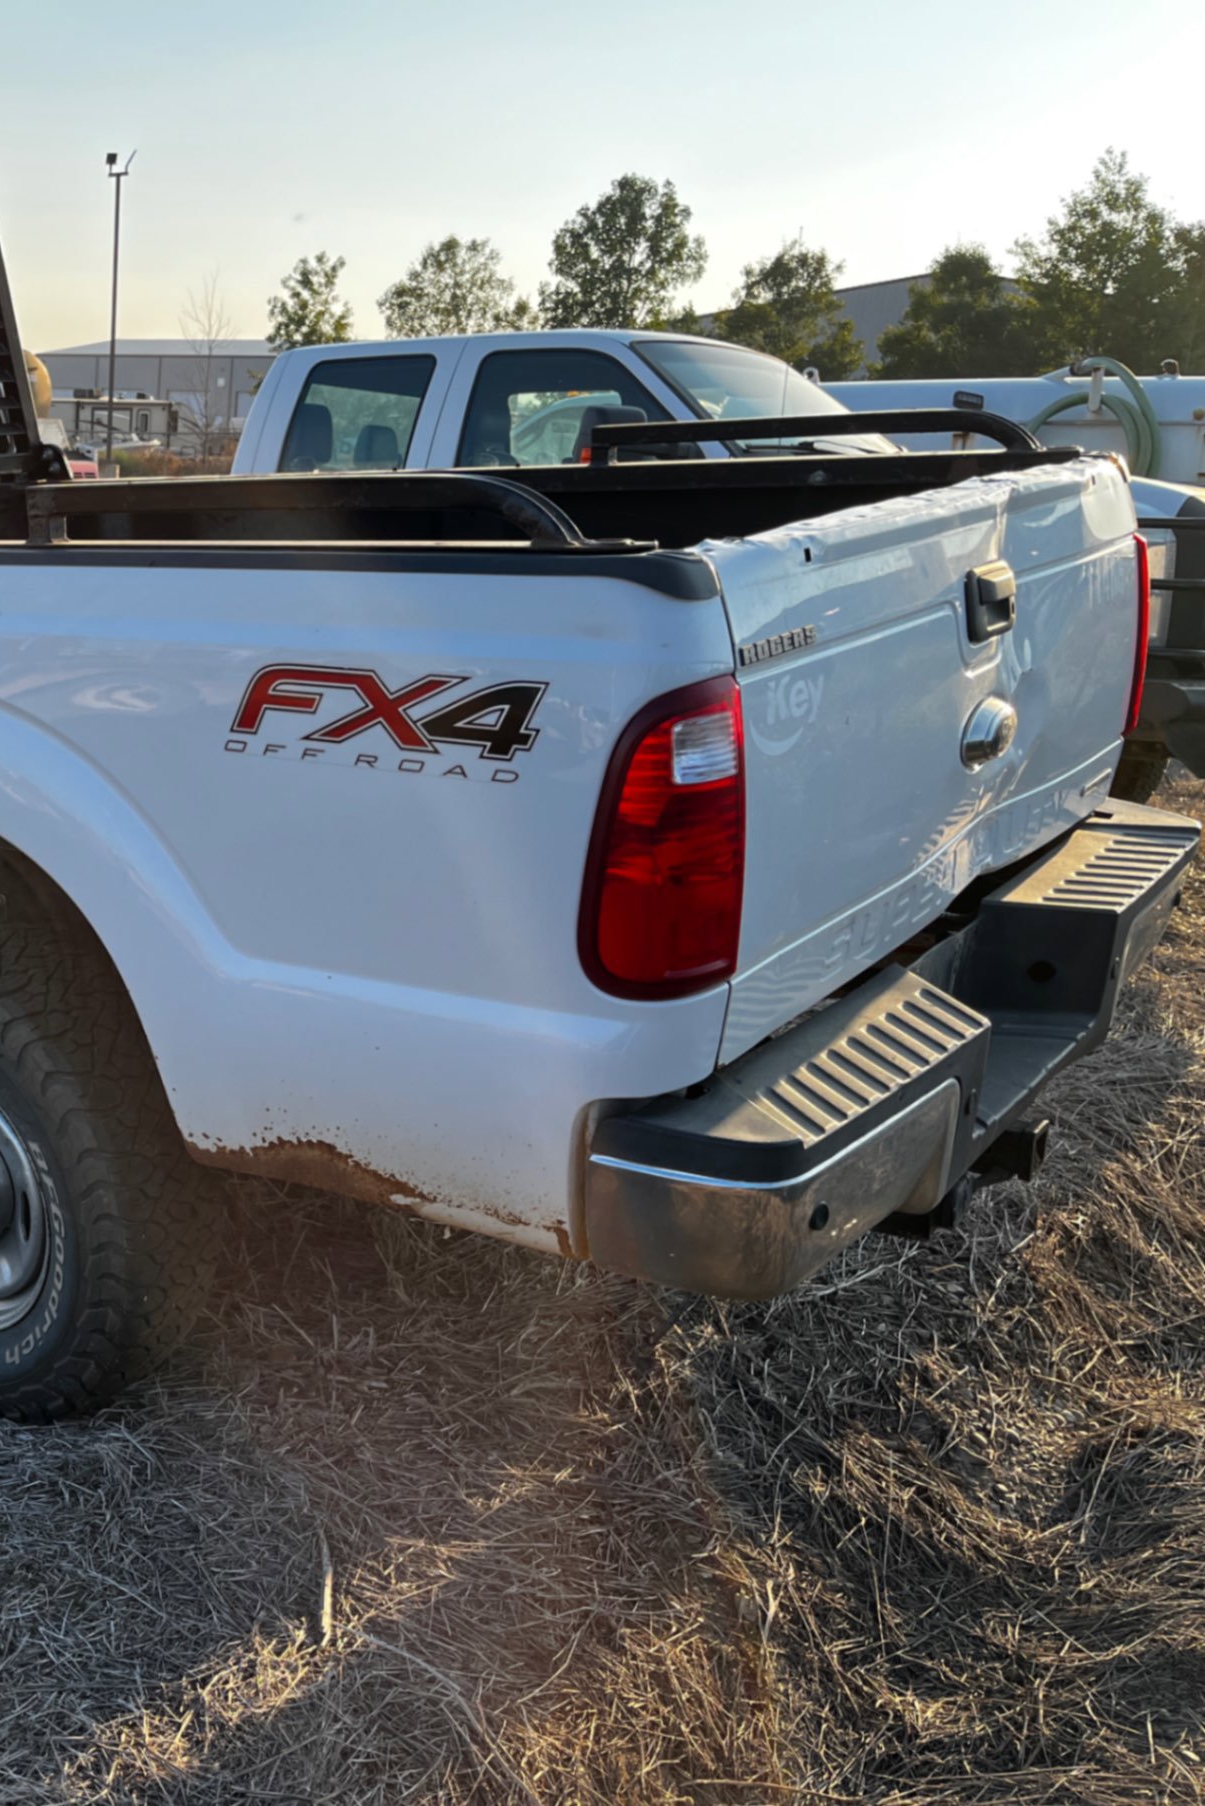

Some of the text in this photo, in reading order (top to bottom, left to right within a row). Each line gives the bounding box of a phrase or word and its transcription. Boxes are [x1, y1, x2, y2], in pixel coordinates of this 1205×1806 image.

[738, 624, 817, 668] ROGERS
[229, 663, 550, 762] FX4
[224, 740, 520, 783] OFF ROAD
[5, 1140, 66, 1366] BFGoodrich
